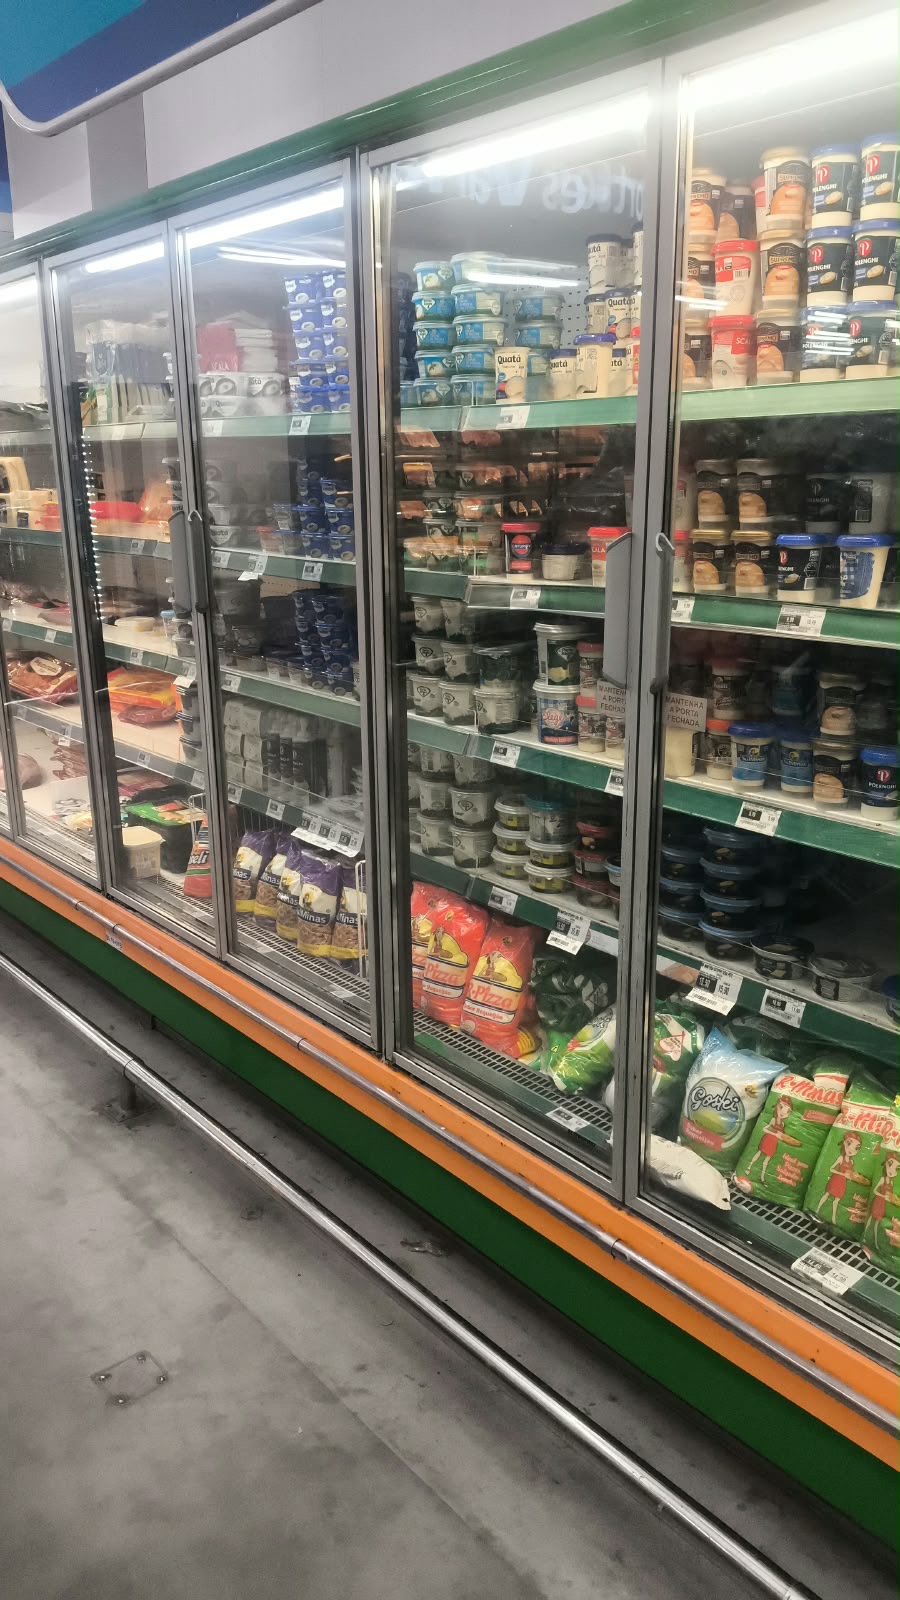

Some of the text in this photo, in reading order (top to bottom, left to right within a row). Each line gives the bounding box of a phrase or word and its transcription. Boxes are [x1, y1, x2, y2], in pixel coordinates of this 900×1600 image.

[497, 354, 521, 364] Quatá
[599, 685, 626, 695] MANTEN
[609, 696, 626, 705] PORT
[665, 696, 704, 709] MANTENHA
[600, 703, 625, 714] FECHAD
[676, 707, 699, 718] PORTA
[667, 715, 700, 727] FECHADA
